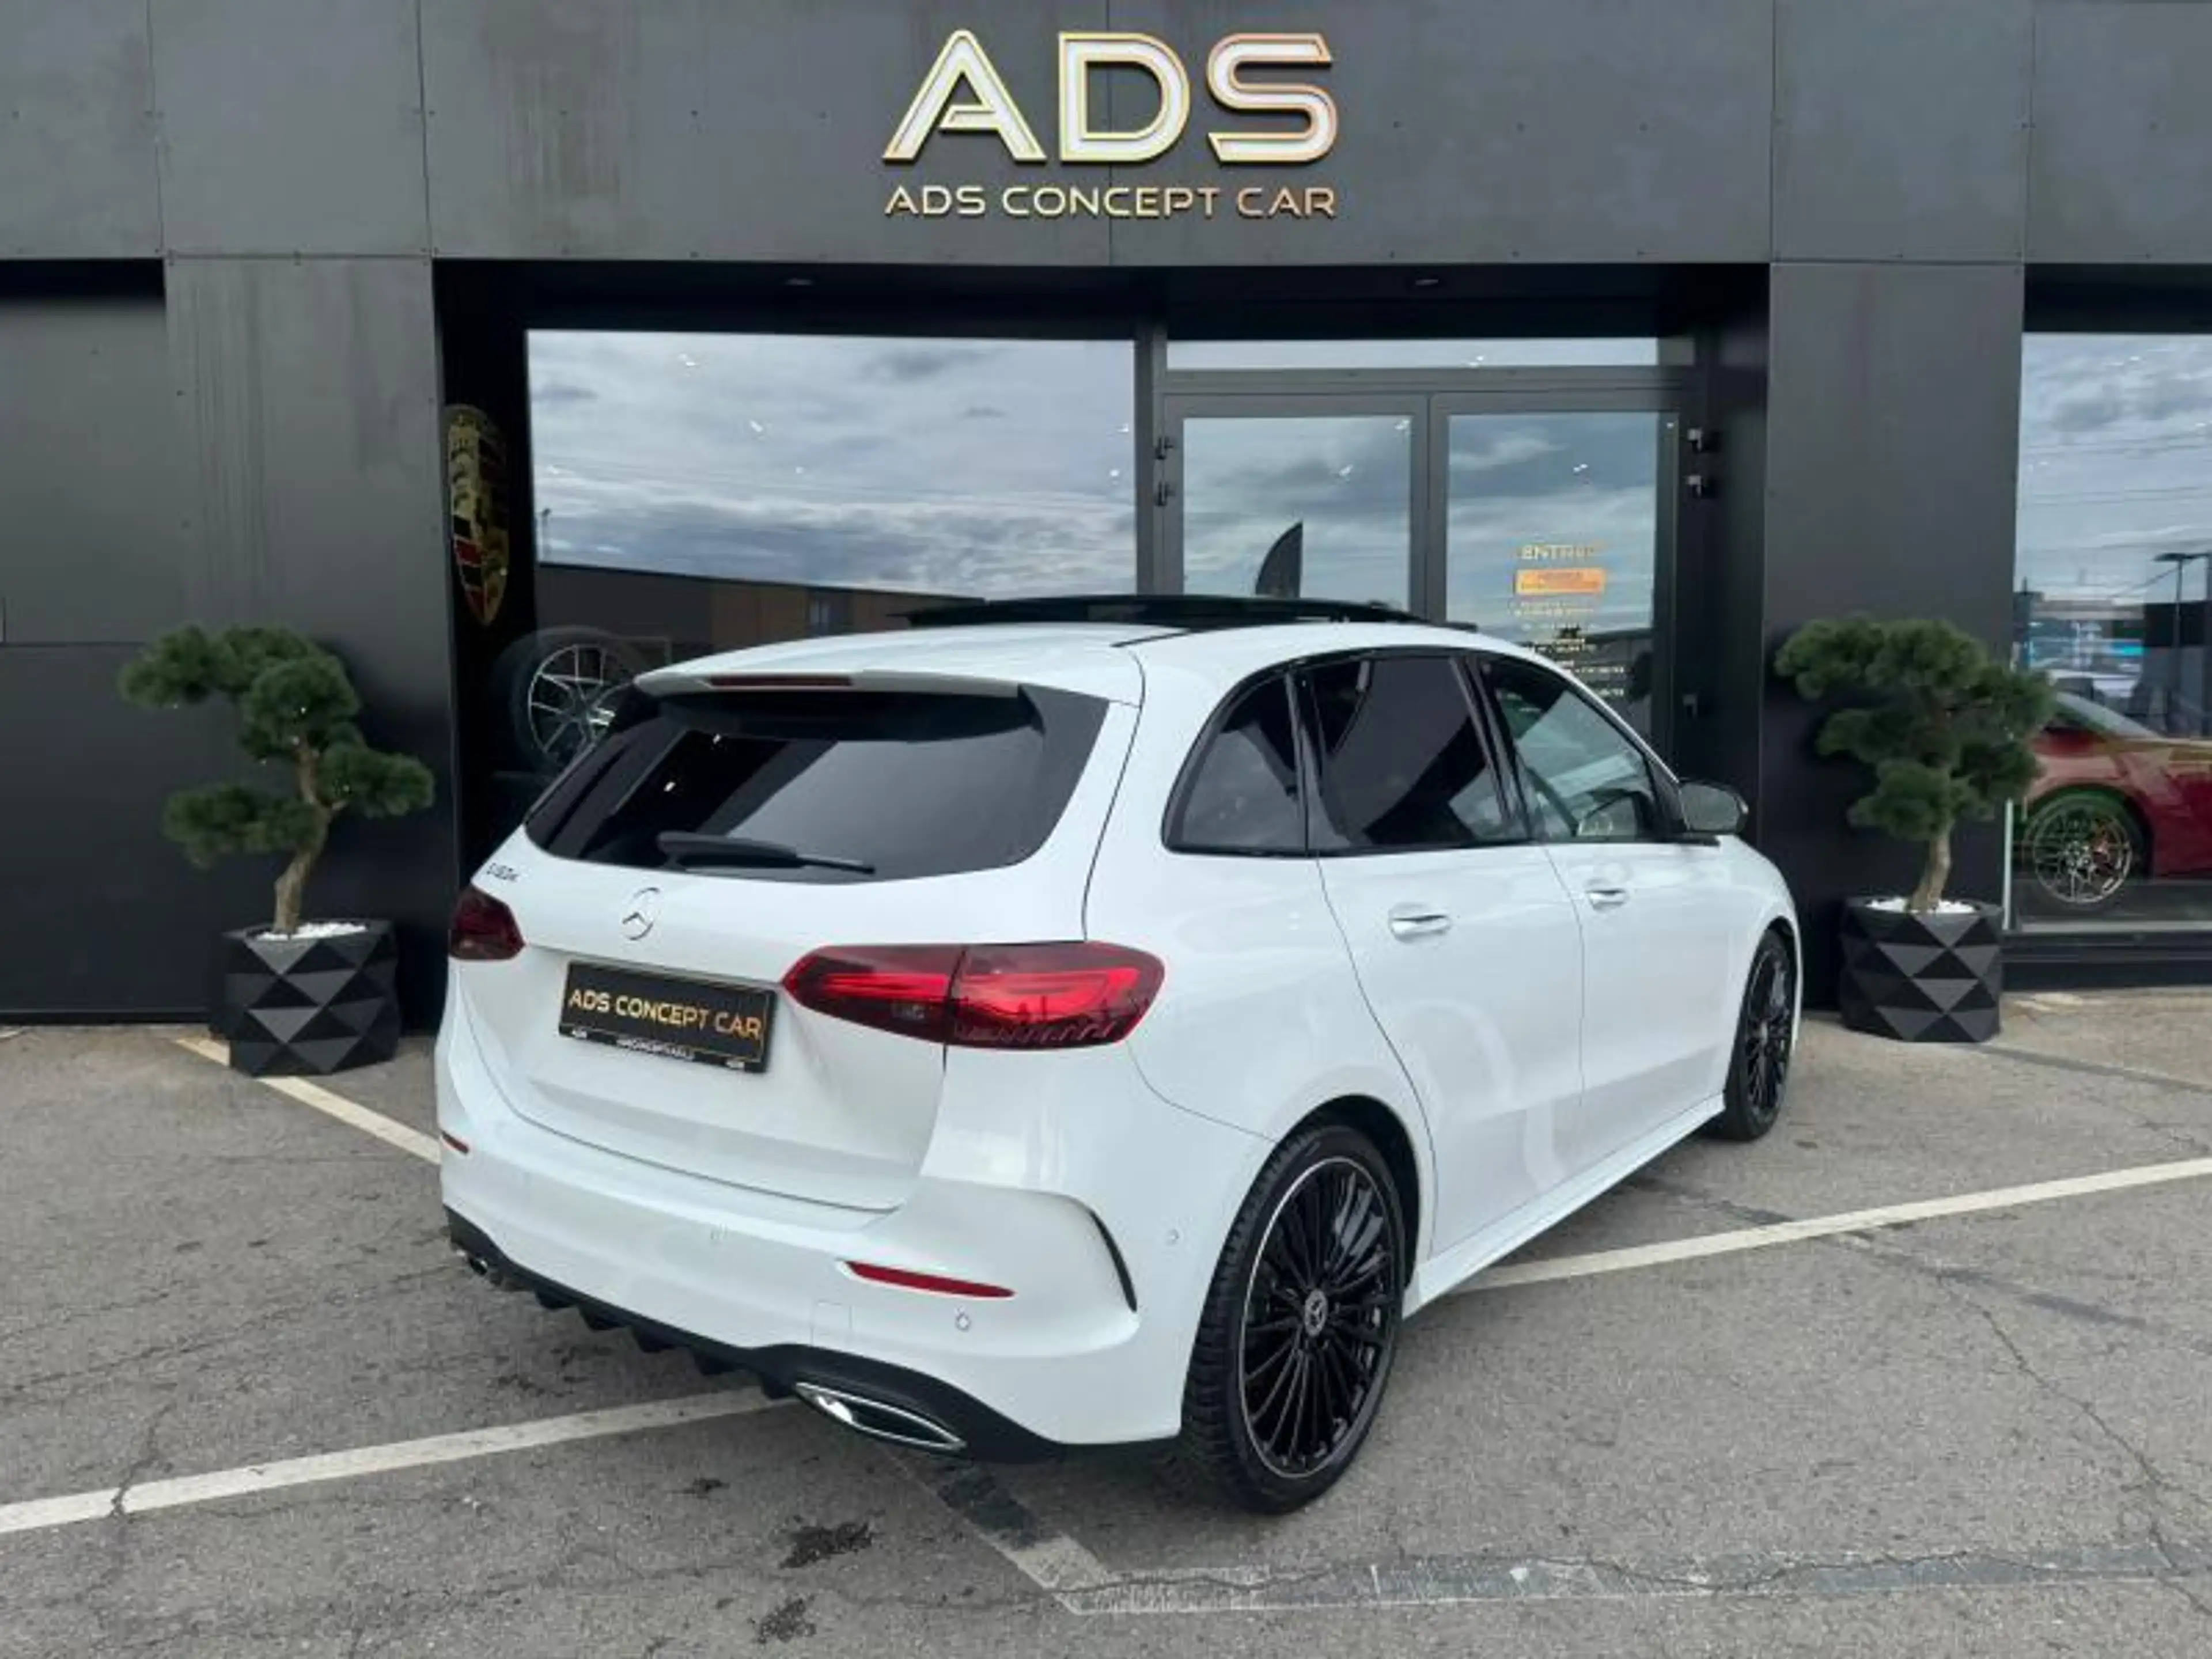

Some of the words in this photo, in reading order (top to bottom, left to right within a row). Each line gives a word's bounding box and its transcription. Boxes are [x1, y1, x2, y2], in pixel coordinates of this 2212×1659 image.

[882, 29, 1338, 162] ADS
[884, 185, 986, 215] ADS
[1002, 186, 1220, 217] CONCEPT
[1237, 186, 1336, 218] CAR
[569, 988, 610, 1013] ADS
[615, 995, 710, 1029] CONCEPT
[714, 1012, 762, 1039] CAR
